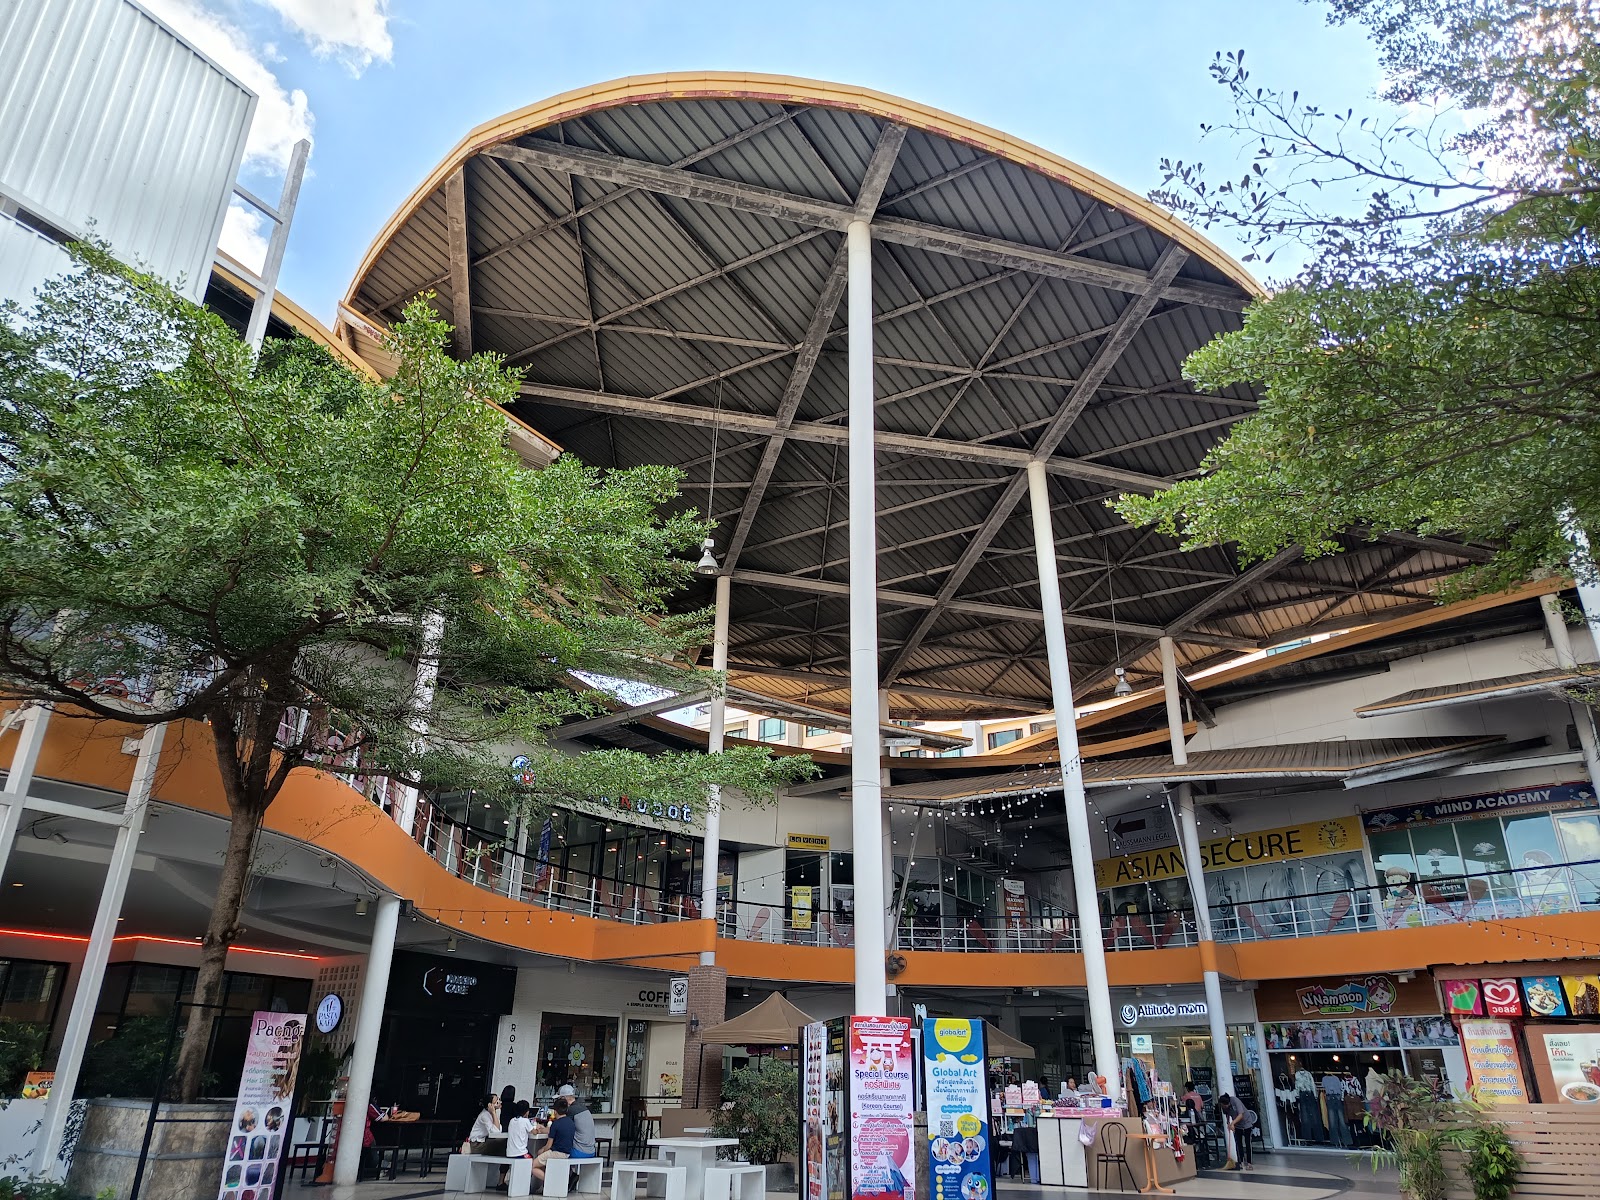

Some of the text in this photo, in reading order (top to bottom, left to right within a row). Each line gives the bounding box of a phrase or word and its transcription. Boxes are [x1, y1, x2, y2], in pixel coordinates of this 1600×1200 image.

[1434, 790, 1551, 814] MIND ACADEMY
[1116, 852, 1186, 882] ASIAN
[1200, 829, 1304, 869] SECURE
[1301, 992, 1363, 1008] N'Nammon
[1138, 1003, 1206, 1016] Attitude mom
[256, 1019, 301, 1042] Paeng
[854, 1069, 909, 1080] Special Course
[932, 1067, 977, 1077] Global Art
[864, 1080, 902, 1090] คอร์สพิเศษ
